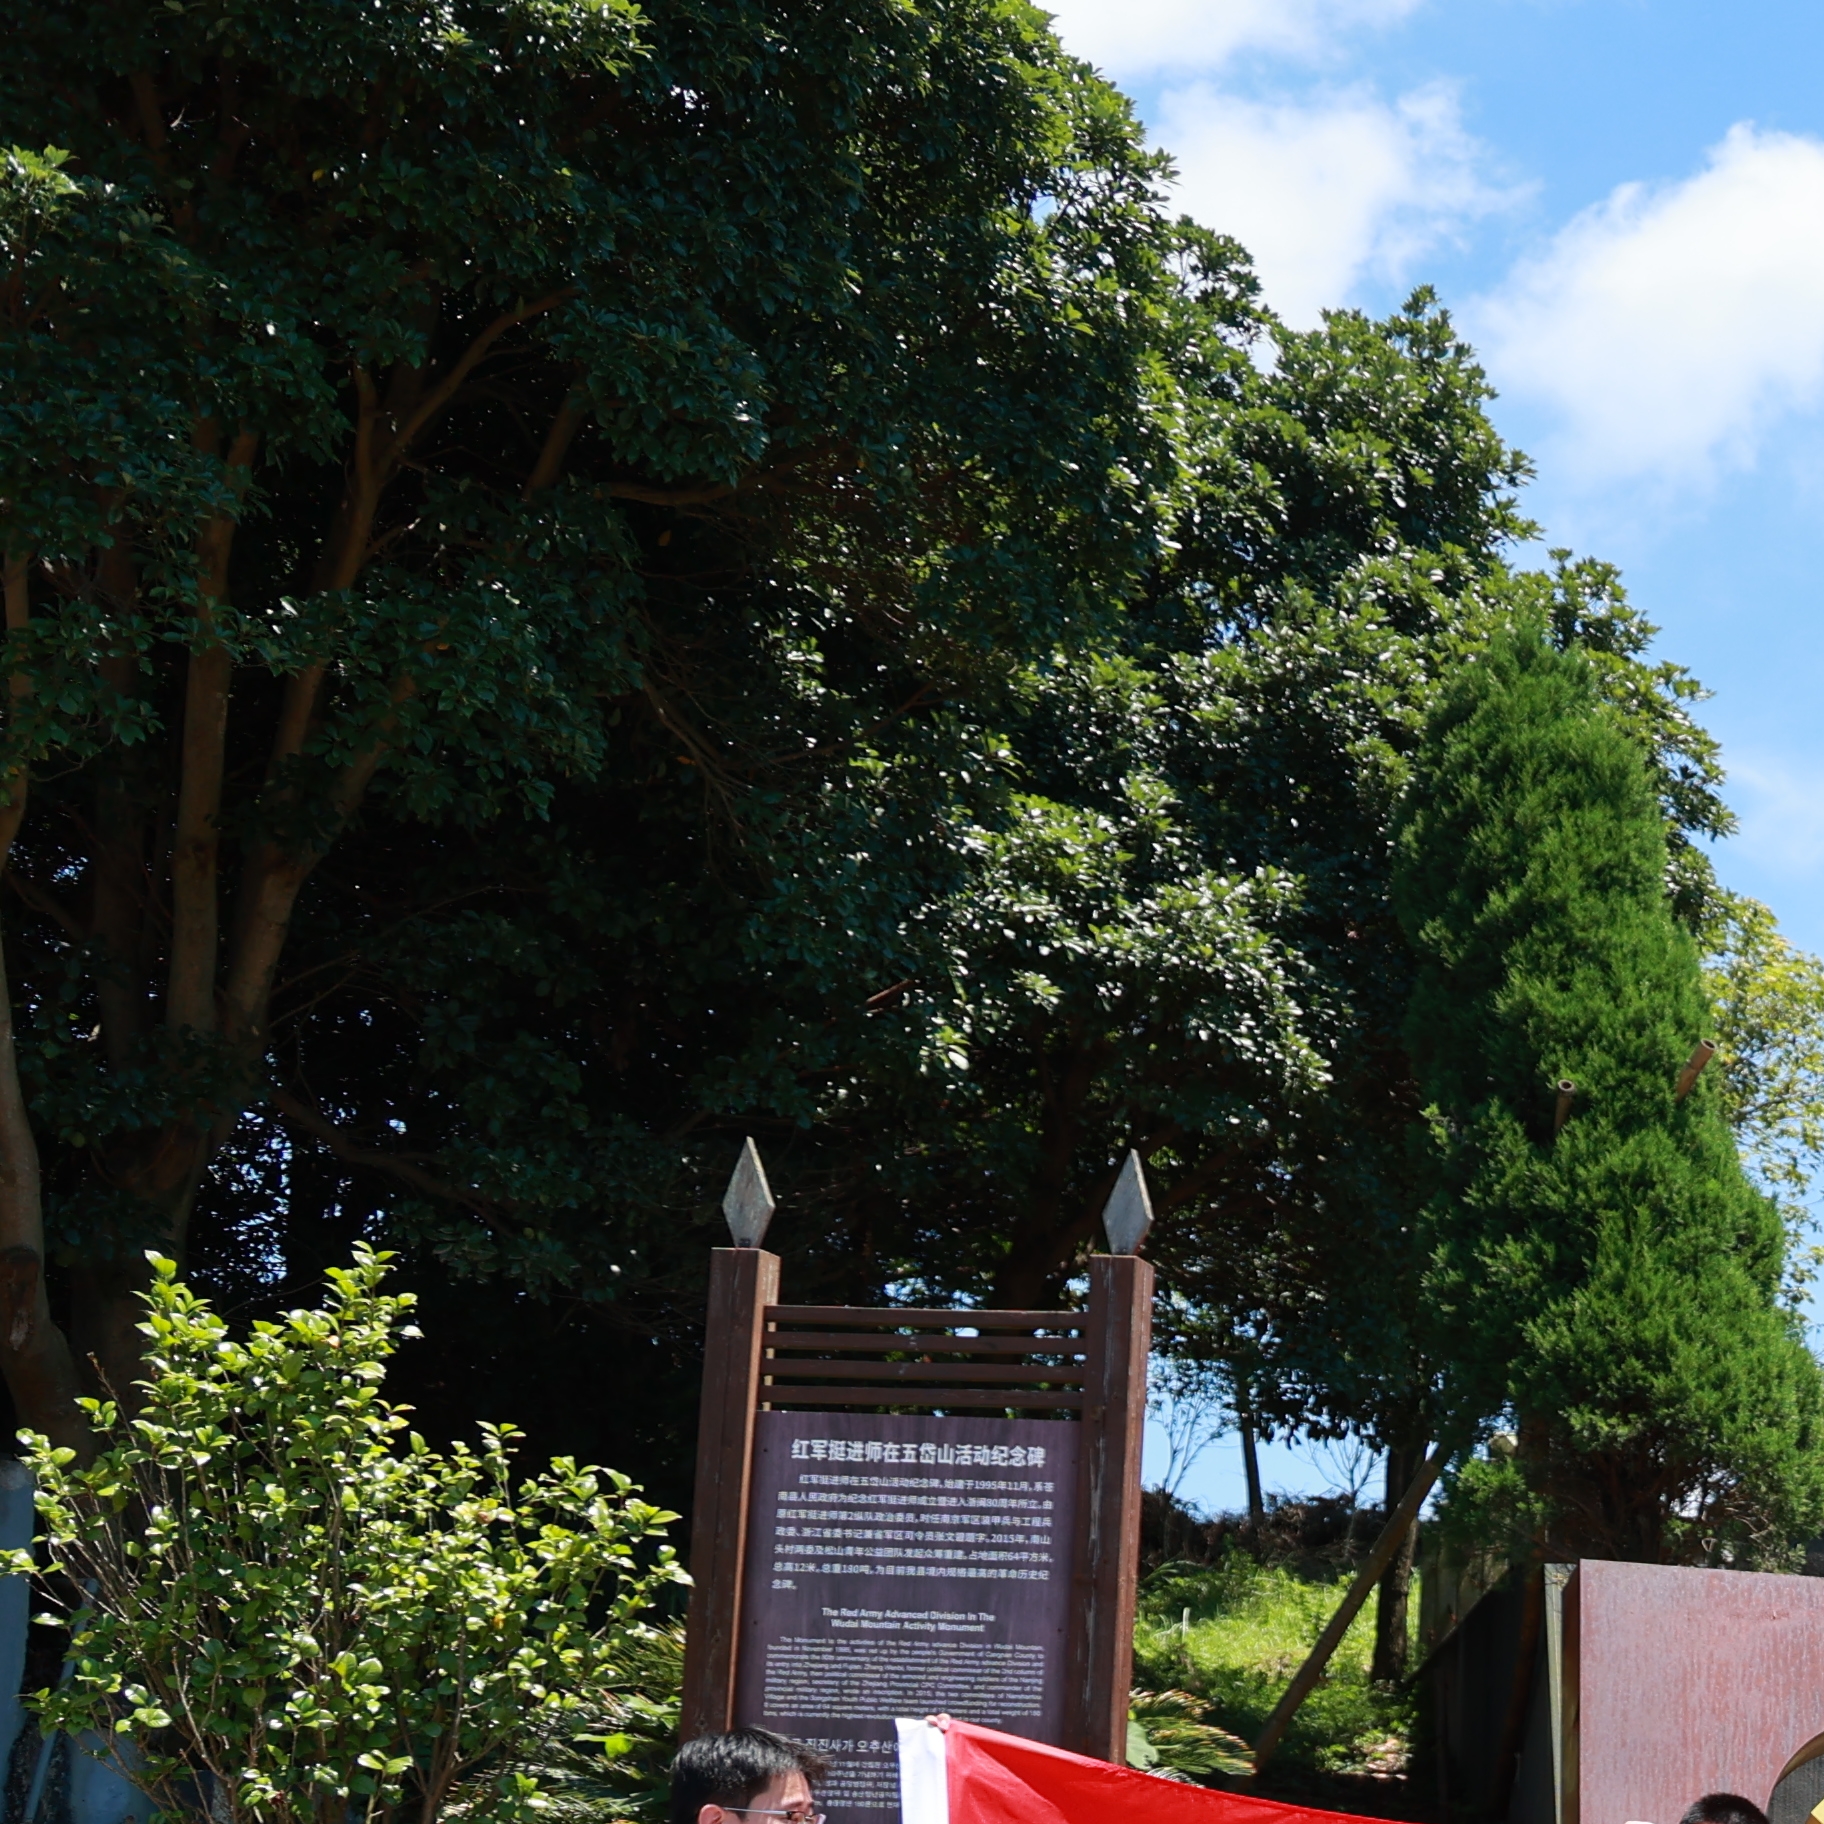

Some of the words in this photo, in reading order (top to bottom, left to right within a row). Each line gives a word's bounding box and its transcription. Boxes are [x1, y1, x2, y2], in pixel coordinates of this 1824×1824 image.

[791, 1438, 1046, 1468] 红军挺进师在五岱山活动纪念碑
[822, 1607, 839, 1617] The
[840, 1608, 858, 1618] Red
[860, 1608, 883, 1620] Army
[930, 1611, 966, 1621] Division
[978, 1612, 996, 1622] The
[860, 1620, 901, 1629] Mountain
[938, 1622, 986, 1632] Monument
